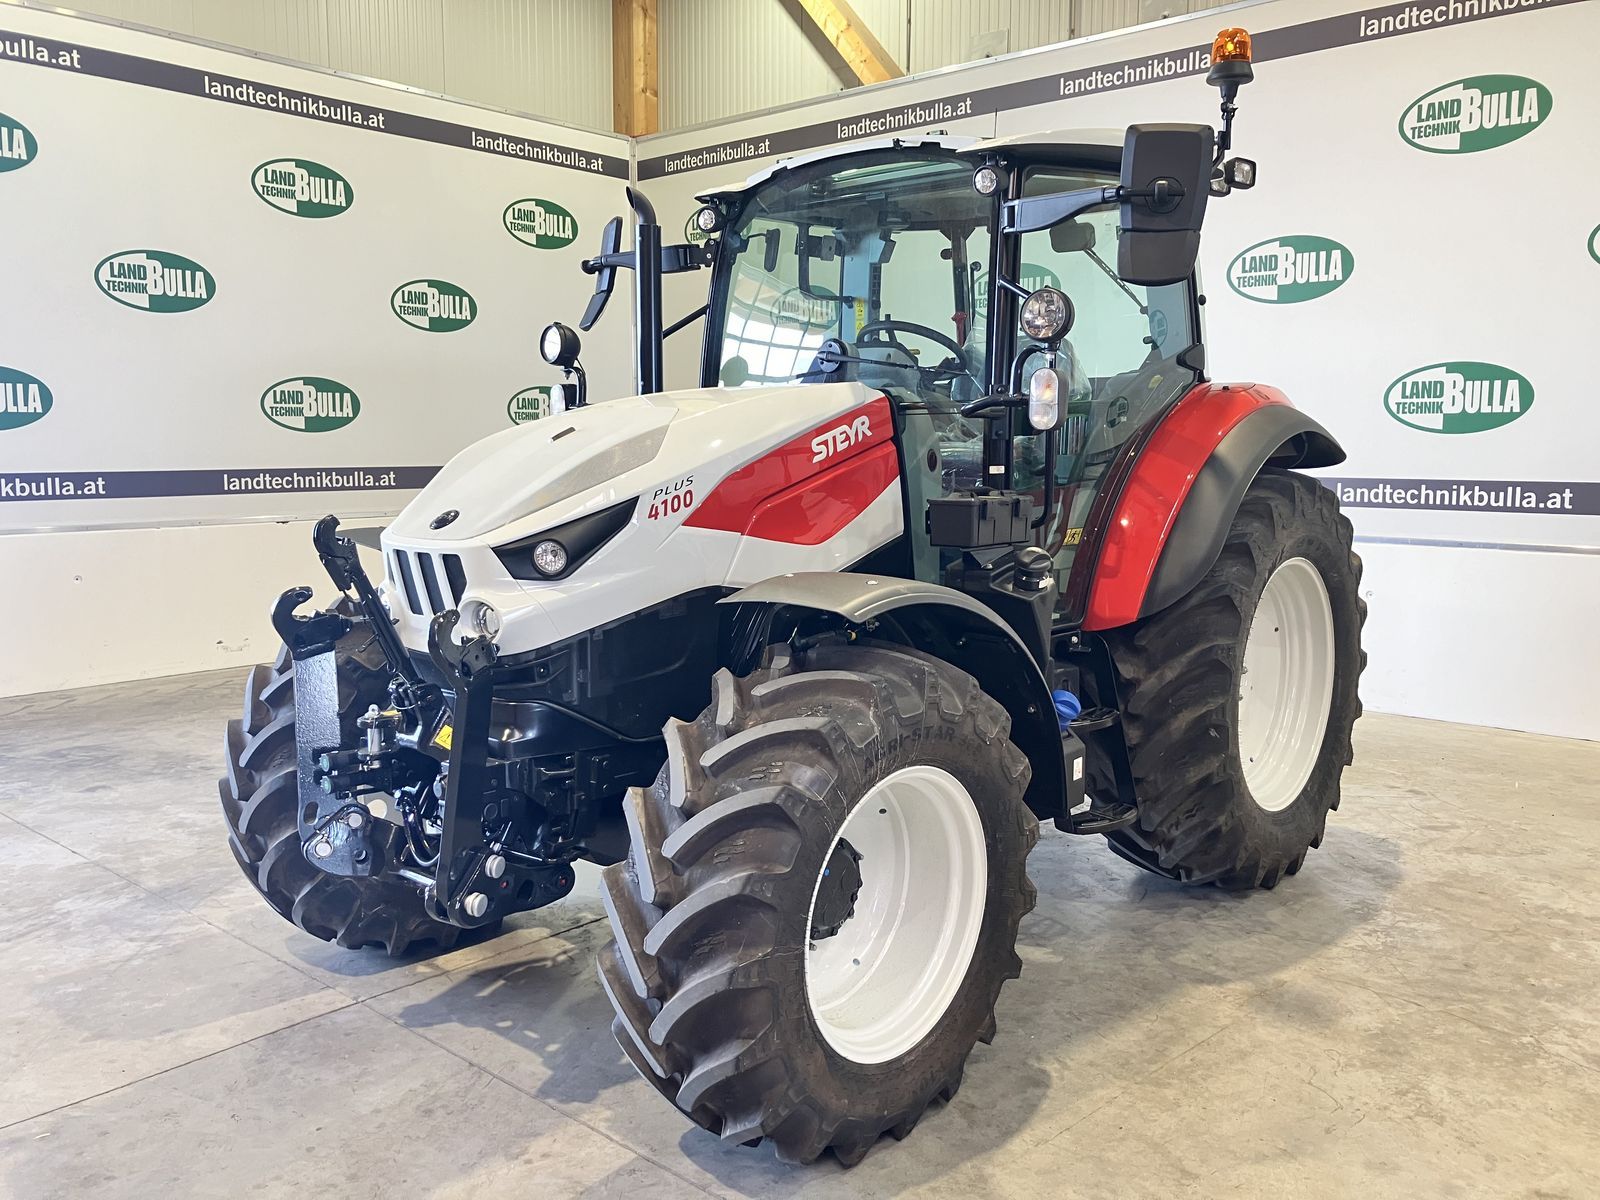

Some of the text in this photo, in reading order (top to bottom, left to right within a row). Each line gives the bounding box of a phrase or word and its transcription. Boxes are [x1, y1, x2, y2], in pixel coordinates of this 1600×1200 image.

[204, 76, 385, 129] landtechnikbulla.at
[1416, 98, 1461, 123] LAND
[1461, 87, 1539, 132] BULLA
[837, 97, 972, 139] landtechnikbulla.at
[1410, 120, 1461, 140] TECHNIK
[471, 131, 603, 172] landtechnikbulla.at
[665, 138, 770, 172] landtechnikbulla.at
[263, 168, 296, 187] LAND
[296, 167, 346, 207] BULLA
[260, 184, 297, 200] TECHNIK
[512, 207, 536, 223] LAND
[535, 206, 573, 239] BULLA
[509, 221, 536, 234] TECHNIK
[109, 261, 147, 281] LAND
[1241, 254, 1278, 273] LAND
[1278, 246, 1343, 285] BULLA
[105, 279, 148, 294] TECHNIK
[147, 259, 207, 299] BULLA
[1236, 273, 1278, 288] TECHNIK
[401, 290, 428, 305] LAND
[428, 287, 471, 320] BULLA
[398, 304, 429, 317] TECHNIK
[272, 389, 304, 405] LAND
[1400, 380, 1445, 399] LAND
[1444, 372, 1520, 415] BULLA
[269, 406, 305, 417] TECHNIK
[303, 385, 353, 418] BULLA
[516, 397, 540, 411] LAND
[1395, 400, 1445, 415] TECHNIK
[513, 411, 540, 421] TECHNIK
[811, 415, 873, 464] STEYR
[223, 470, 396, 490] landtechnikbulla.at
[652, 474, 694, 500] PLUS
[647, 489, 693, 521] 4100
[1336, 482, 1574, 510] landtechnikbulla.at
